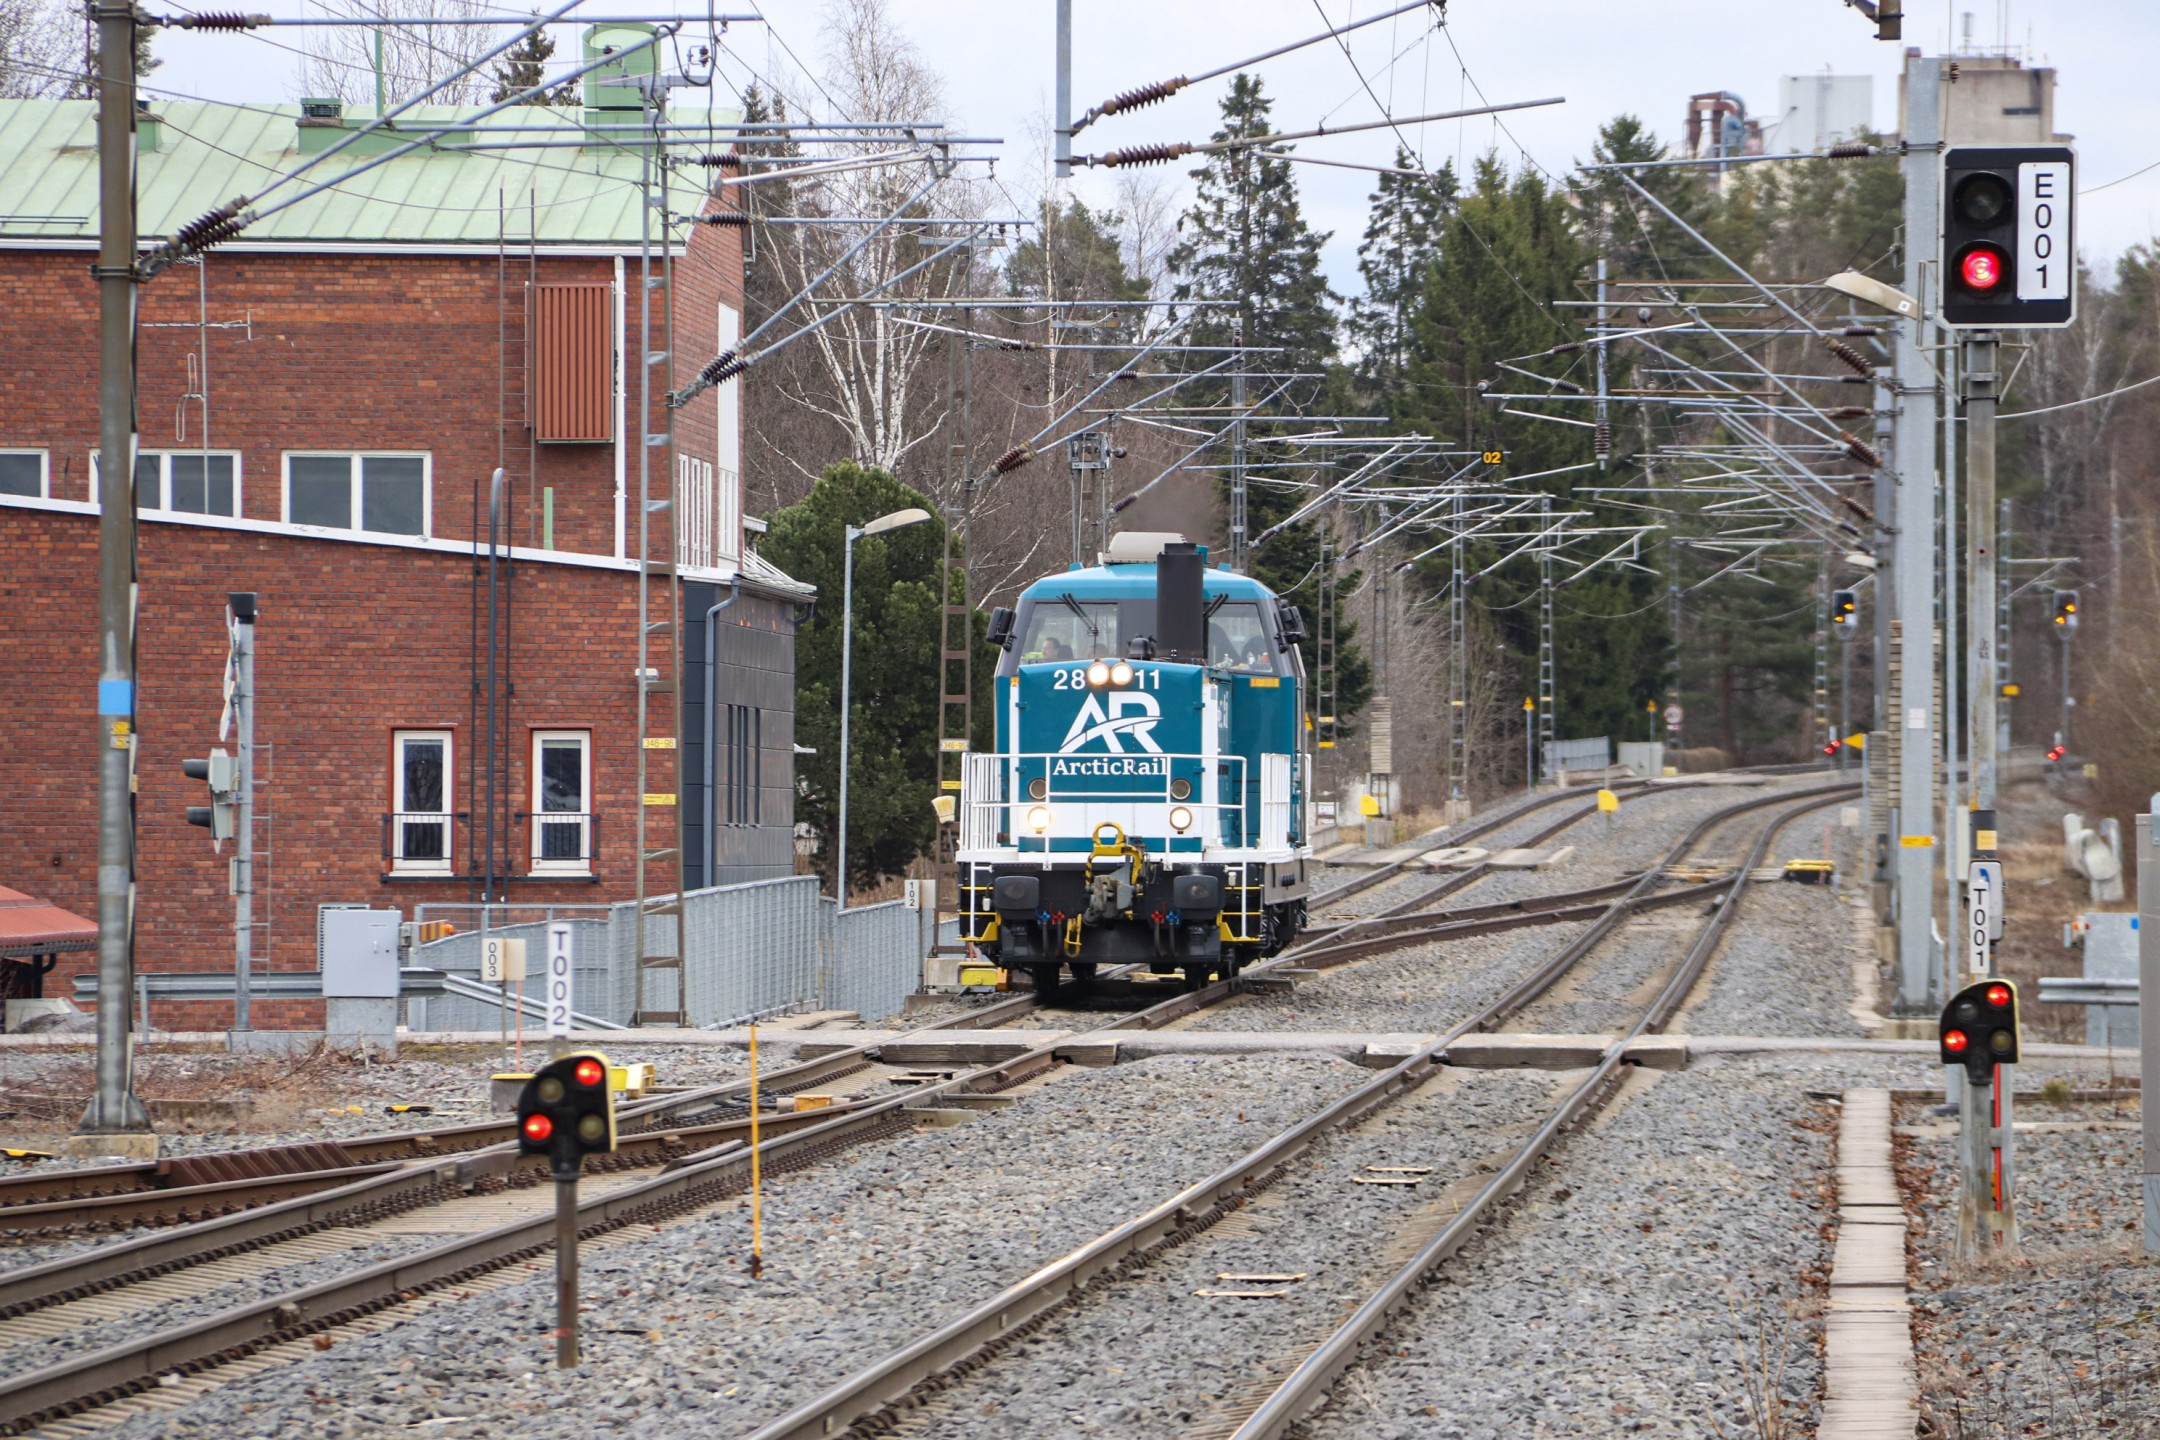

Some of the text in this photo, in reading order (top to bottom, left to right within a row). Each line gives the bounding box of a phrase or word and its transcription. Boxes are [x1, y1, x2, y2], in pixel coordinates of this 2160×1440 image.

[2035, 173, 2053, 289] E001
[1483, 451, 1501, 464] 02
[1053, 669, 1160, 690] 28 11
[1058, 691, 1165, 753] AR
[1052, 758, 1168, 776] ArcticRail
[1973, 888, 1987, 967] T001
[488, 942, 497, 977] 003
[552, 931, 568, 1026] T002
